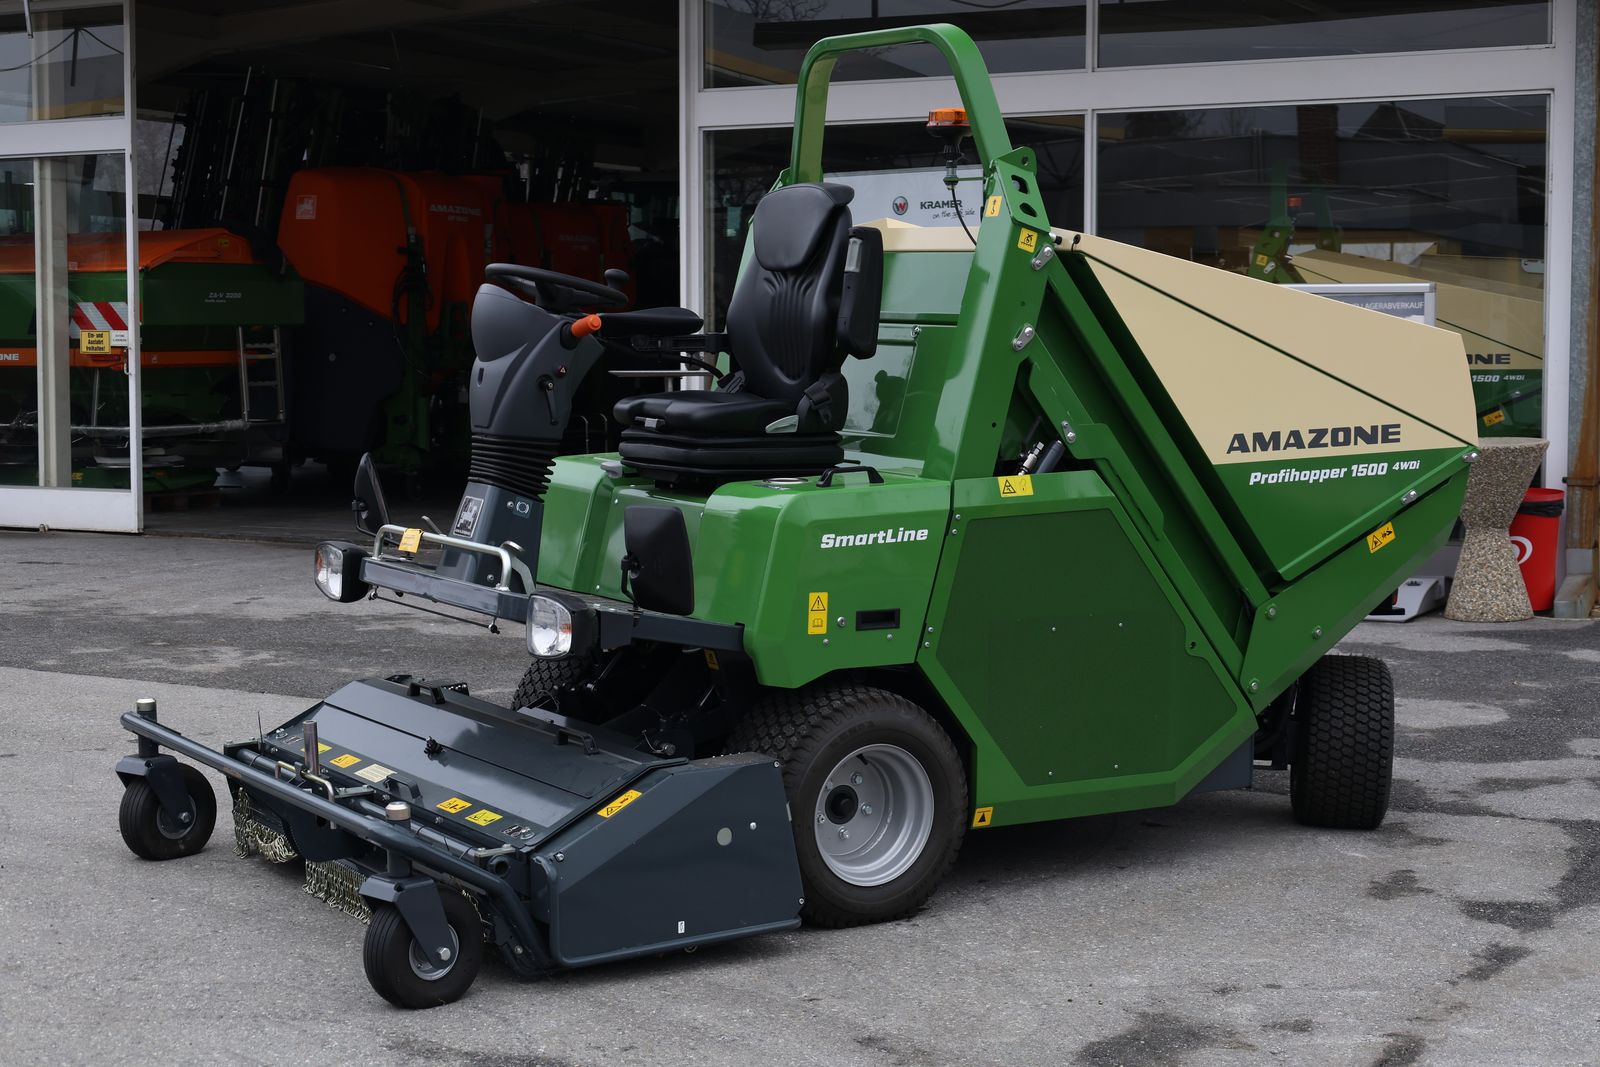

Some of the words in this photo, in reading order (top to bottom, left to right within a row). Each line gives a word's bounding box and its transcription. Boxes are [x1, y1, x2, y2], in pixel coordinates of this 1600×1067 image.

[920, 200, 963, 210] KRAMER
[1472, 374, 1500, 383] 1500
[1226, 423, 1401, 455] AMAZONE
[1249, 466, 1348, 486] Profihopper
[1350, 462, 1389, 477] 1500
[1392, 459, 1421, 471] 4WDi
[820, 528, 928, 549] SmartLine
